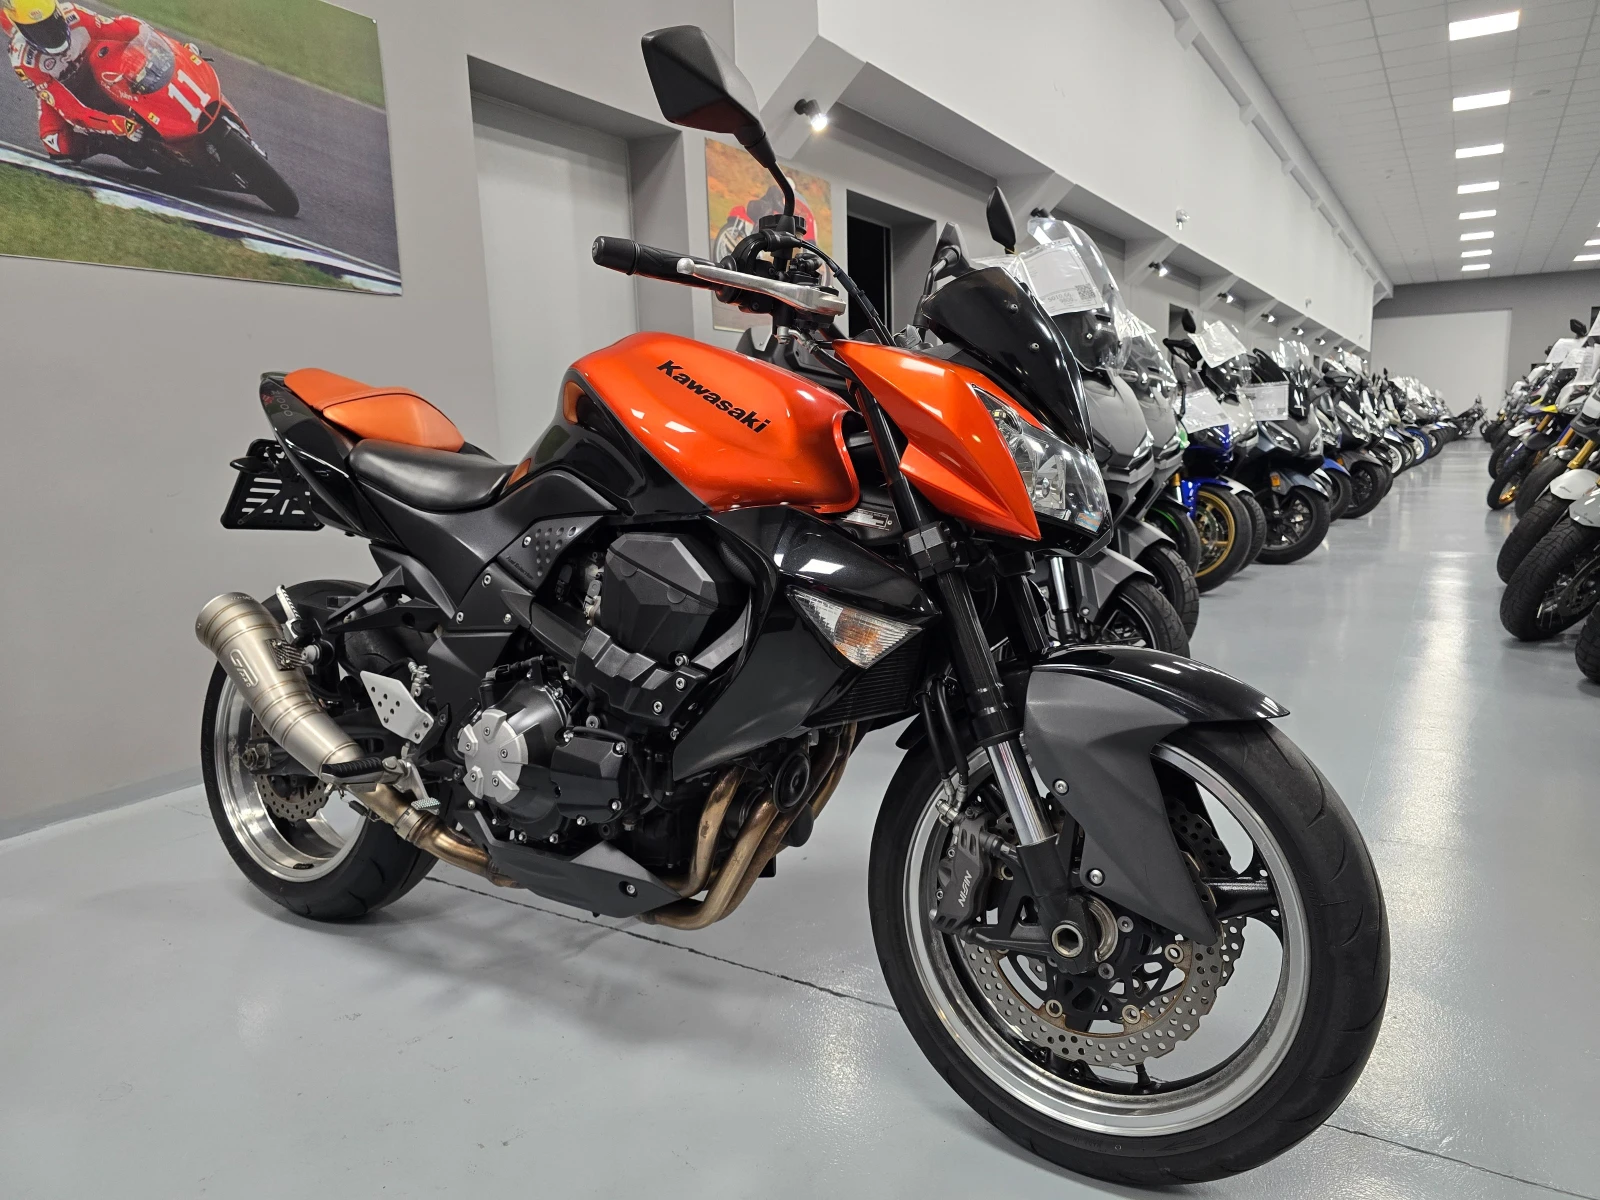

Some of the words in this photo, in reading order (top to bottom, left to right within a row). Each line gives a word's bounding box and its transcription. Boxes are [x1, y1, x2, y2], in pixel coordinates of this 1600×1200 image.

[168, 69, 212, 124] 11
[656, 360, 771, 433] Kawasaki
[957, 869, 973, 908] NISSIN
